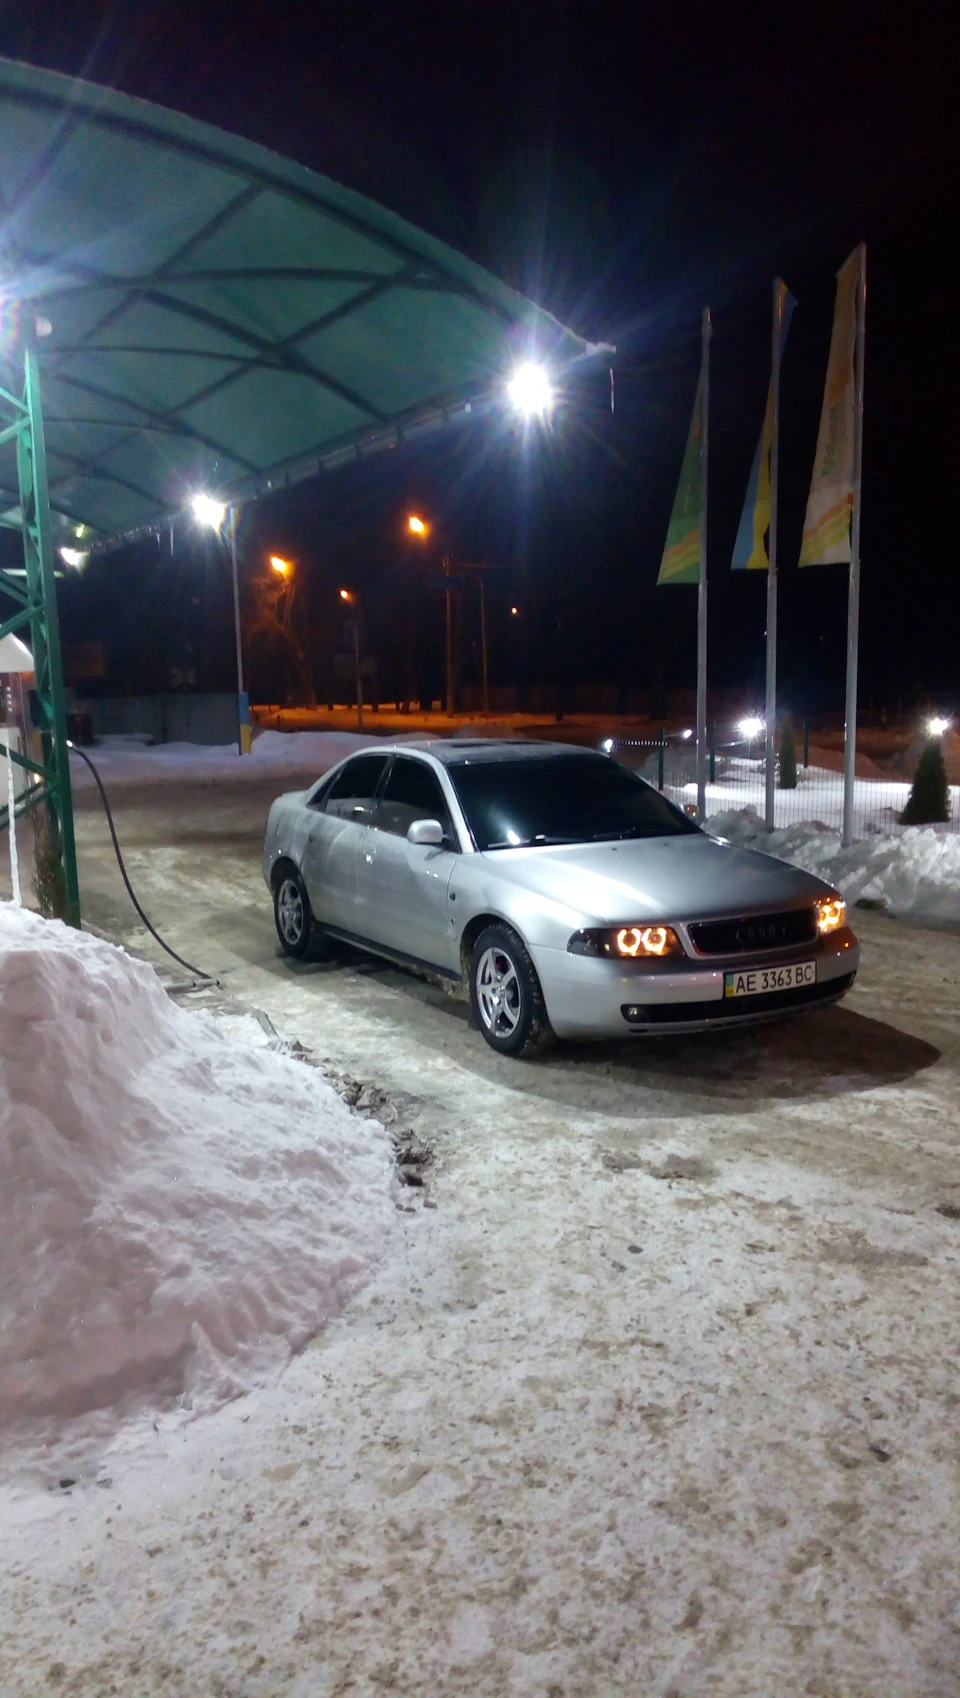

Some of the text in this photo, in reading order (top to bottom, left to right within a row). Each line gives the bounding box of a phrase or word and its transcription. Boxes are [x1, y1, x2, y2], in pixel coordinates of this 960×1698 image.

[736, 966, 812, 993] AE 3363 BC
